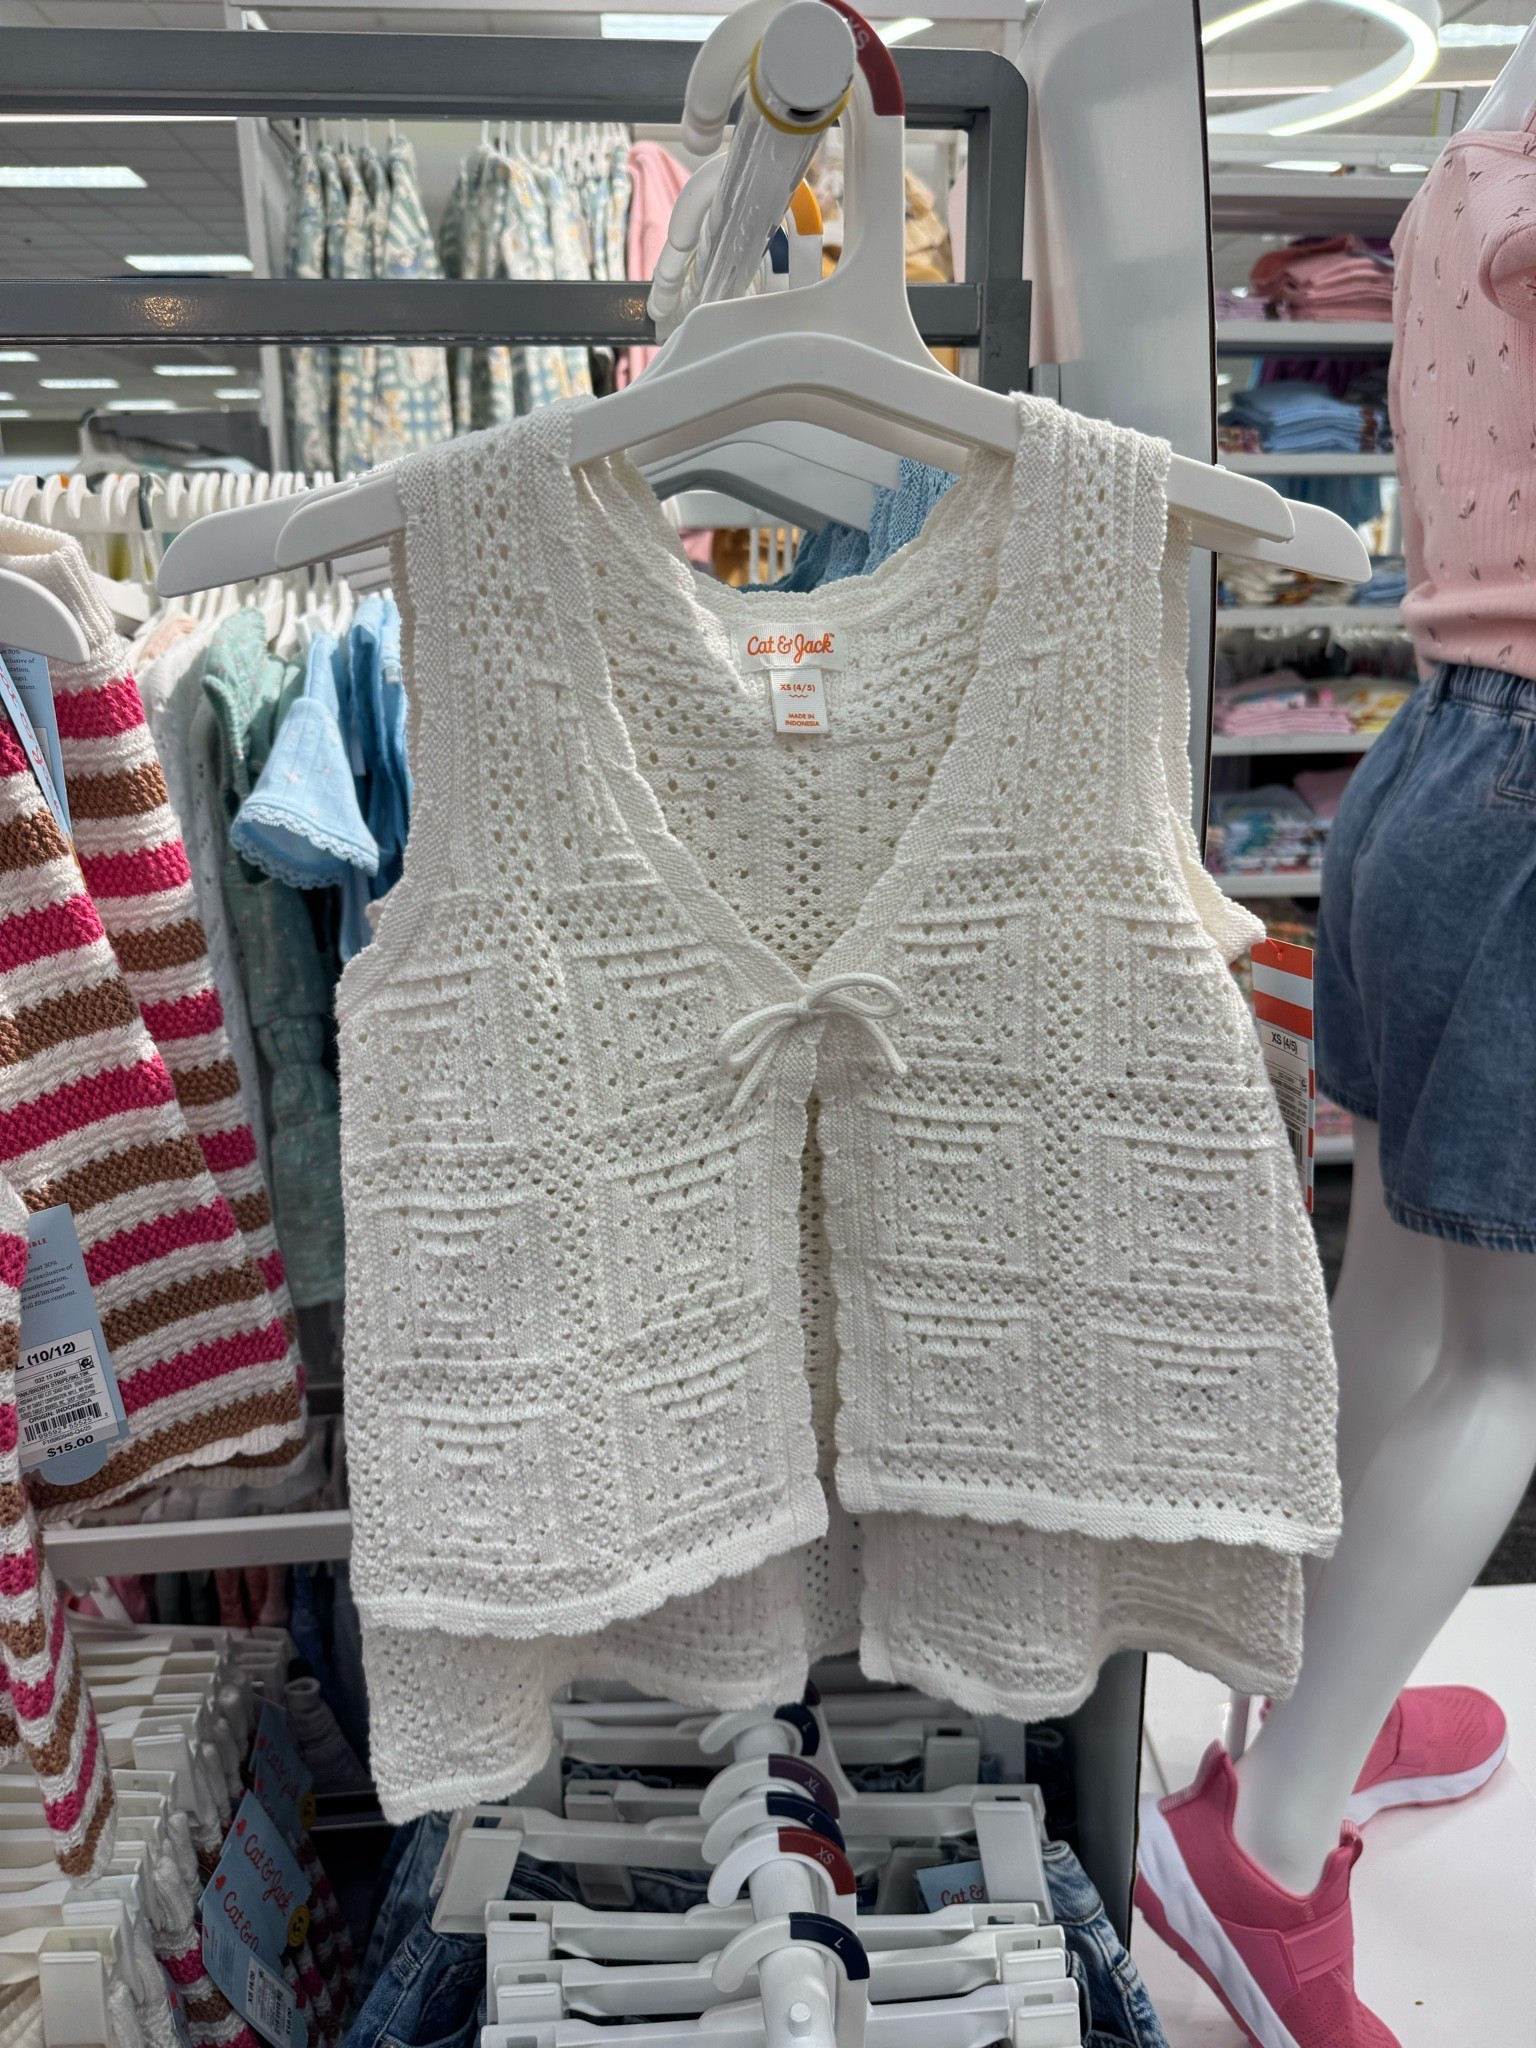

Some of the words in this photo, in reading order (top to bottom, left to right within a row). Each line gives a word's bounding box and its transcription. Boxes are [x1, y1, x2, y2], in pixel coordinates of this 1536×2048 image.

[747, 635, 776, 656] Cat
[777, 635, 793, 654] &
[780, 683, 792, 691] XS
[793, 683, 816, 693] (4/5)
[1271, 1031, 1283, 1046] XS
[1283, 1035, 1298, 1055] (4/5)
[27, 1341, 76, 1366] (10/12)
[55, 1397, 93, 1414] INDONESIA
[38, 1427, 62, 1440] 99592
[68, 1417, 93, 1430] 55525
[46, 1435, 94, 1458] $15.00
[803, 1775, 820, 1793] XL
[806, 1812, 816, 1824] L
[244, 1834, 266, 1870] Cat
[815, 1846, 835, 1865] XS
[261, 1857, 276, 1882] &
[262, 1869, 295, 1917] Jack
[940, 1887, 970, 1907] Cat
[969, 1884, 985, 1901] &
[223, 1891, 245, 1930] Cat
[240, 1920, 254, 1945] &
[834, 1936, 845, 1950] L
